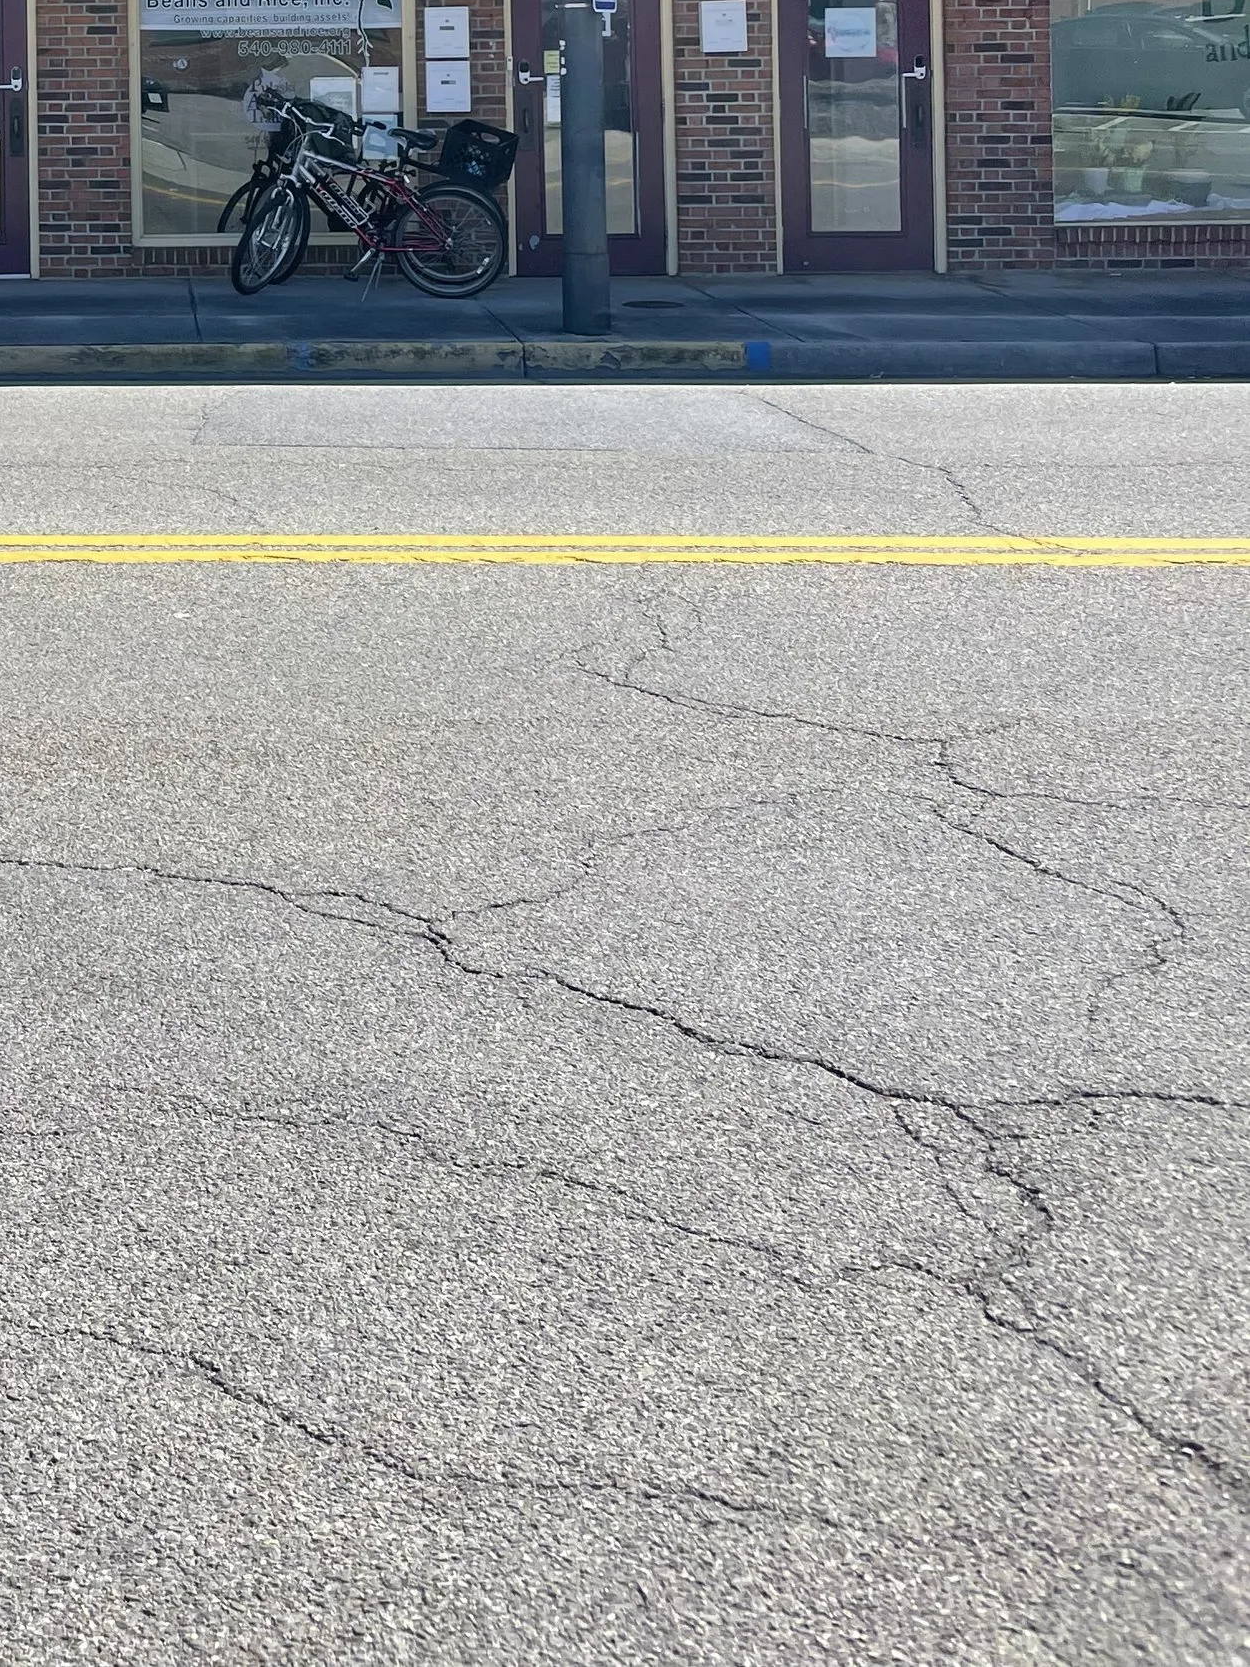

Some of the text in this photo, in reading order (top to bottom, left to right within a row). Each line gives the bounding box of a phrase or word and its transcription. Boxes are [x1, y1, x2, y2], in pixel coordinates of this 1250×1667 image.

[173, 14, 214, 24] Growing
[273, 13, 311, 24] building
[200, 26, 351, 39] www.beansandrice.org
[238, 38, 352, 56] 540-980-4111
[1205, 24, 1250, 62] and
